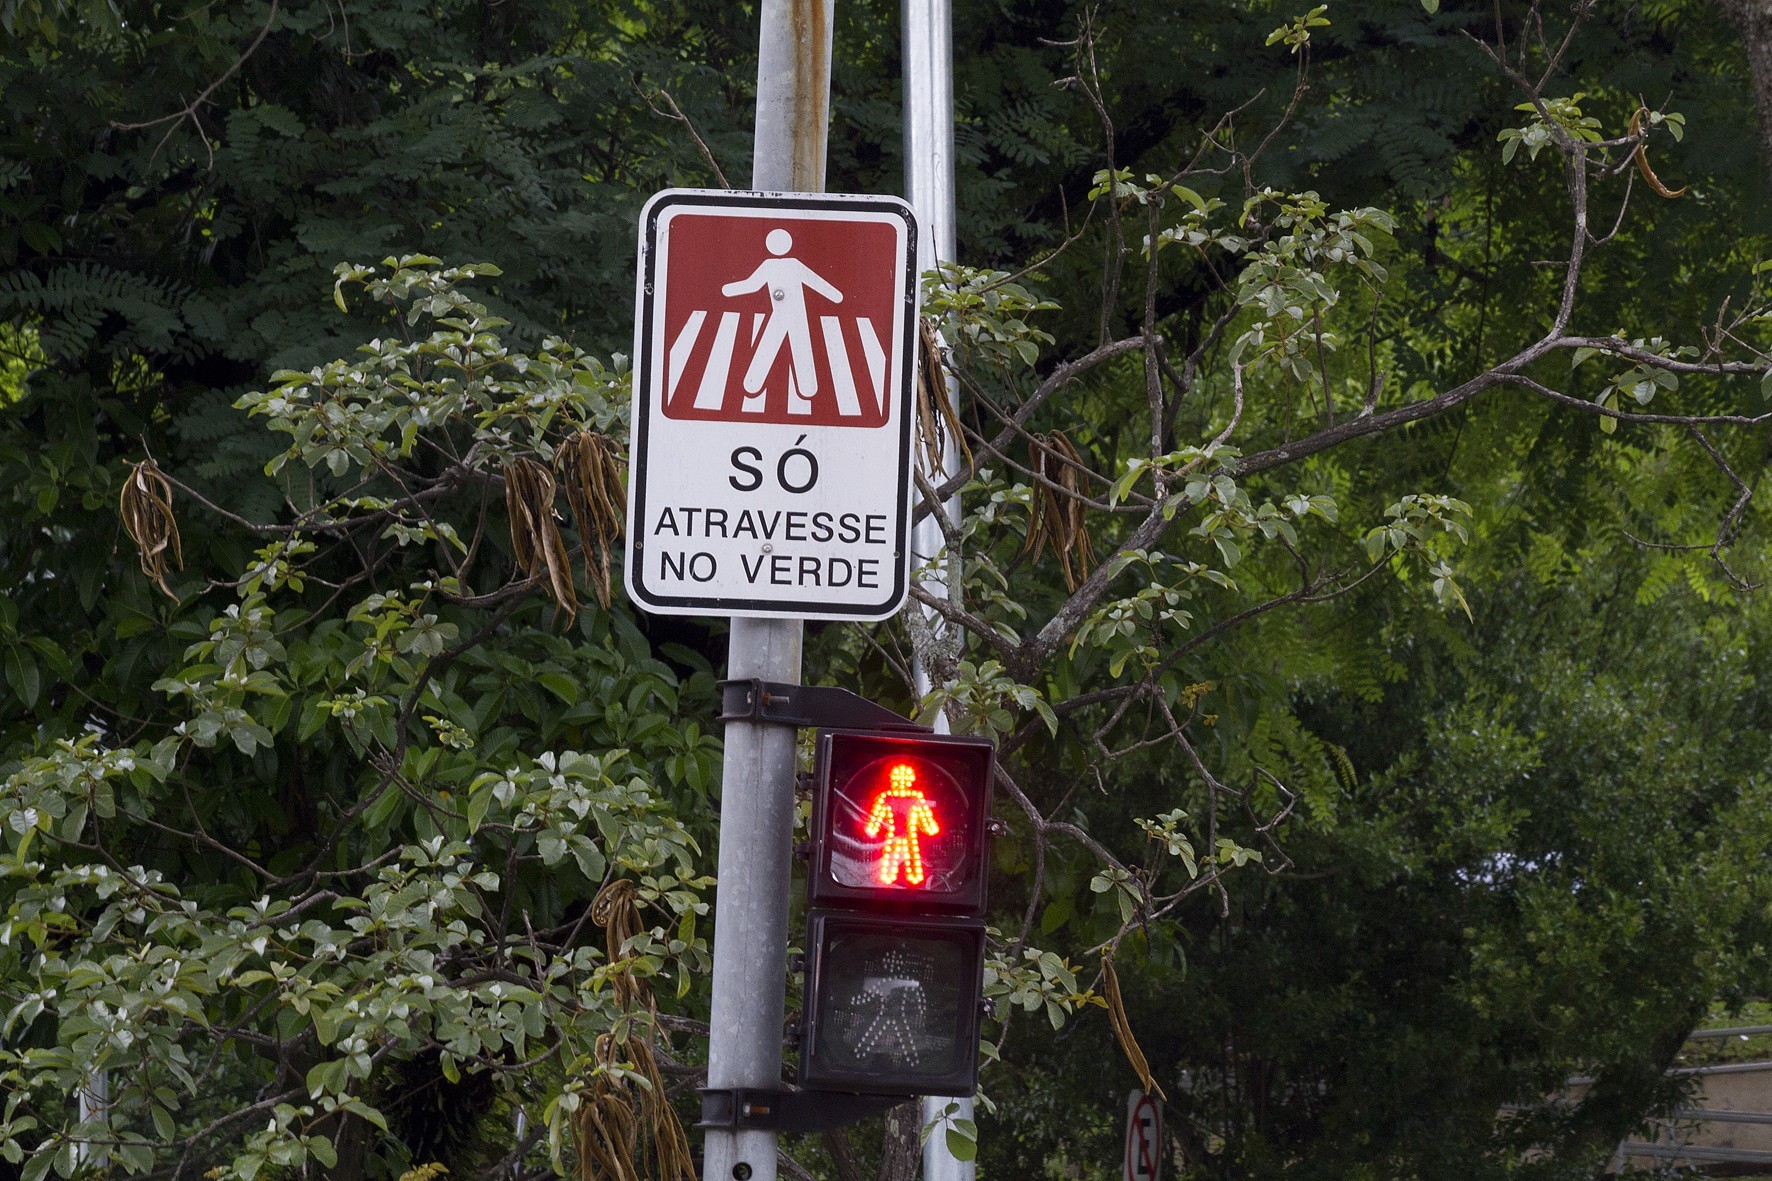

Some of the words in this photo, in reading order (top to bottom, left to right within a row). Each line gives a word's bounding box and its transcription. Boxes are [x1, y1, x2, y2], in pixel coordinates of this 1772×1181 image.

[728, 434, 819, 494] SÓ
[653, 506, 887, 545] ATRAVESSE
[660, 551, 718, 583] NO
[740, 553, 880, 589] VERDE
